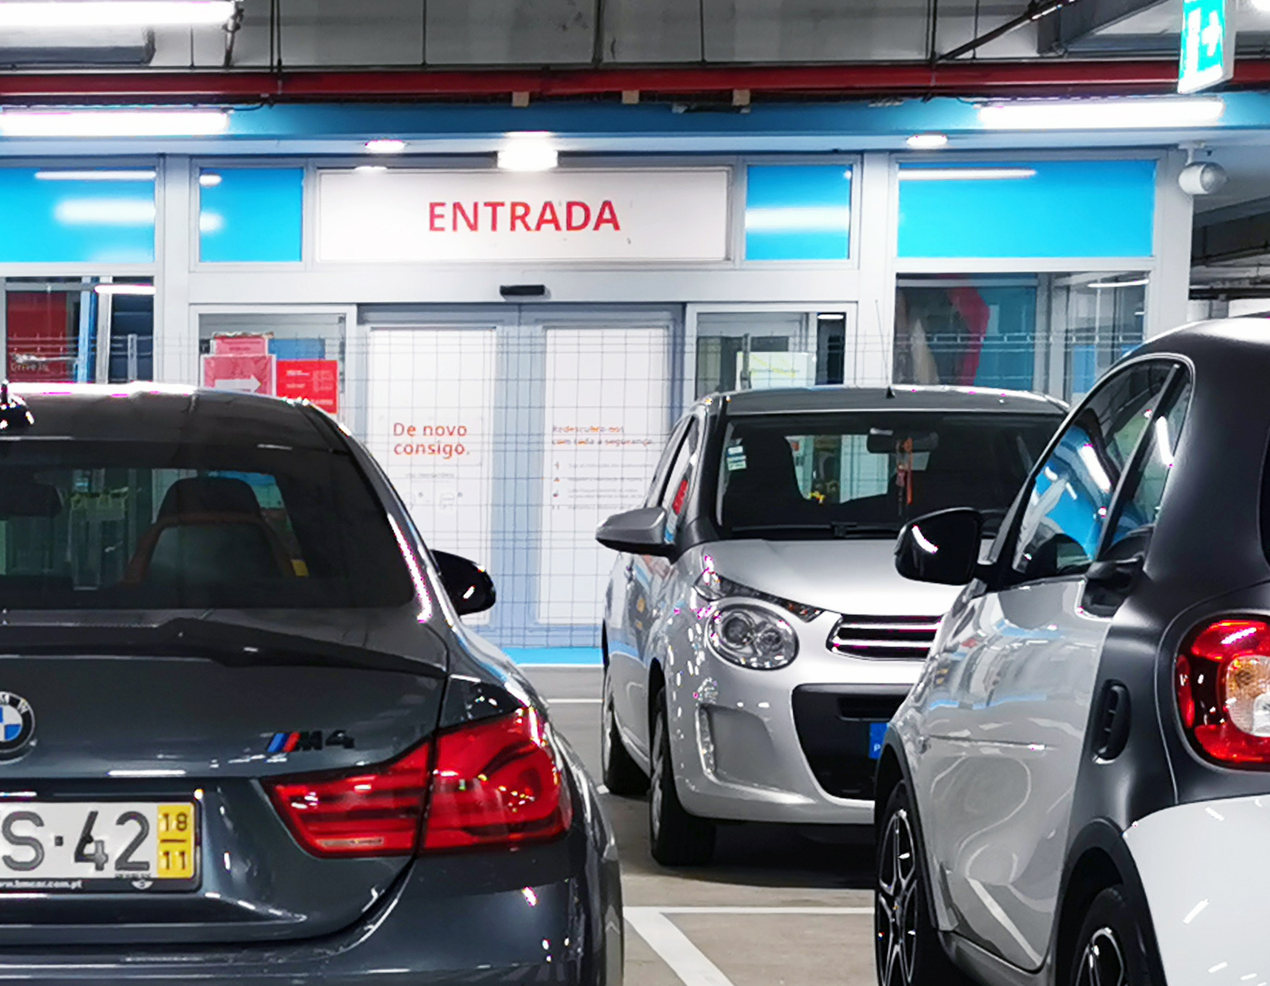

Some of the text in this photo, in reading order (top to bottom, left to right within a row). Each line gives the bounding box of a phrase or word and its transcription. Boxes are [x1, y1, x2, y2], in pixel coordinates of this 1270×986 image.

[429, 200, 621, 232] ENTRADA
[393, 422, 467, 437] De novo
[393, 440, 470, 460] consigo.
[160, 812, 188, 832] 18
[160, 850, 188, 871] 11
